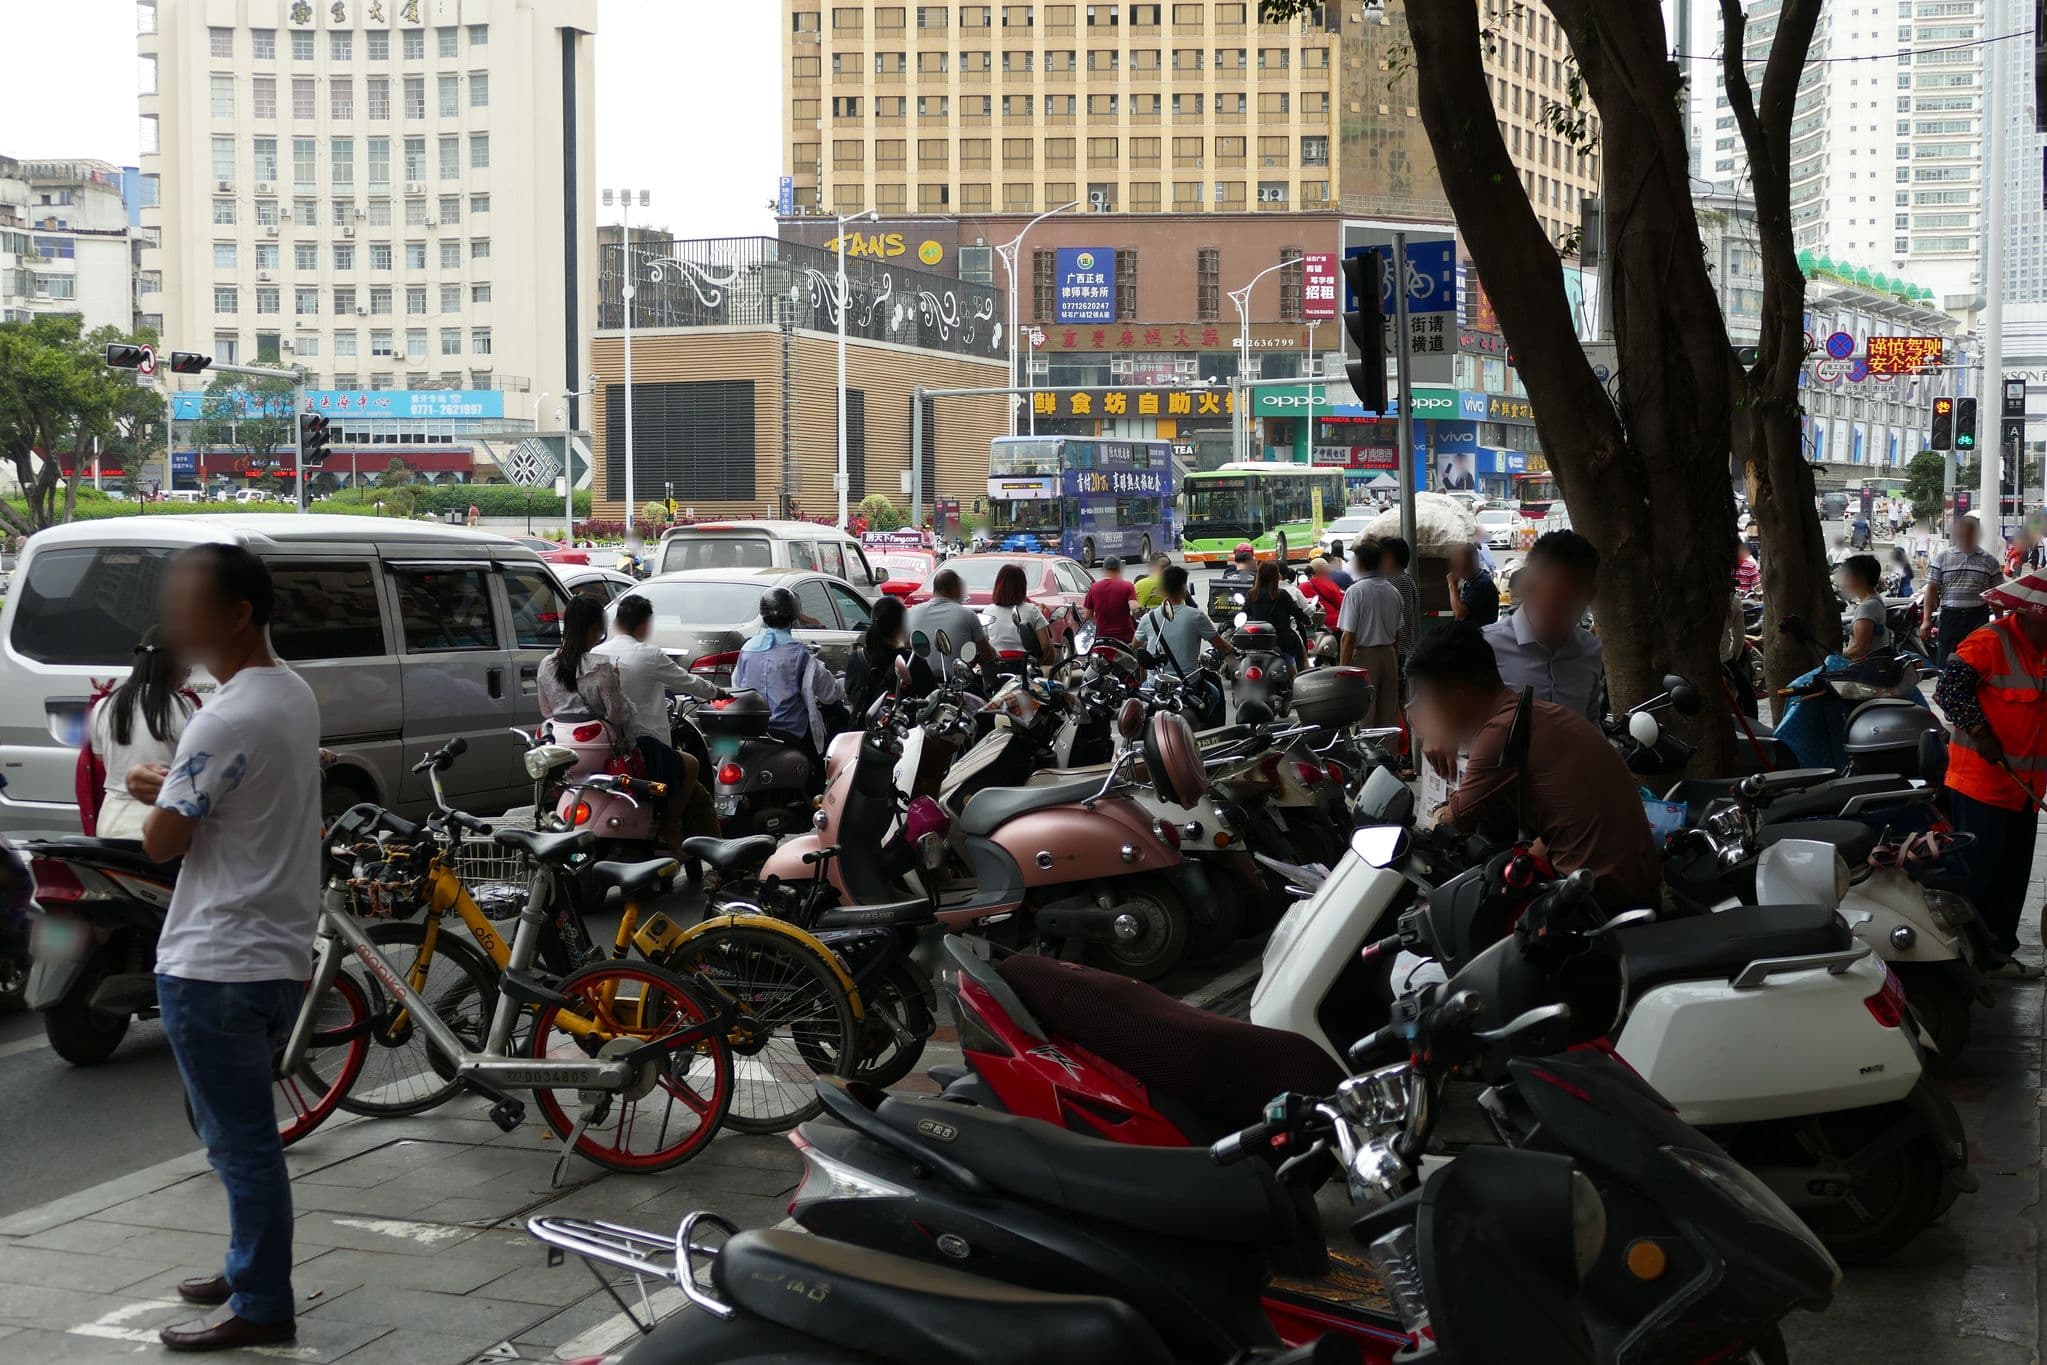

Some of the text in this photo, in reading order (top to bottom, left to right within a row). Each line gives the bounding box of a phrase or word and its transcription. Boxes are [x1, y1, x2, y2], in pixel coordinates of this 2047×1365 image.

[781, 177, 790, 186] P
[824, 232, 906, 258] FANS
[1066, 272, 1104, 284] 广西正权
[1062, 286, 1108, 298] 律师事务所
[1305, 285, 1334, 300] 招租
[1869, 338, 1942, 356] 谨慎驾驶
[1262, 396, 1326, 408] oppo
[1464, 397, 1484, 412] vivo
[411, 404, 482, 415] 0771-2621997
[1440, 432, 1474, 442] vivo
[2010, 427, 2020, 436] A
[1174, 446, 1194, 454] TEA
[1320, 448, 1346, 458] 中国电信
[474, 927, 494, 950] ofo
[356, 944, 406, 1000] mobike
